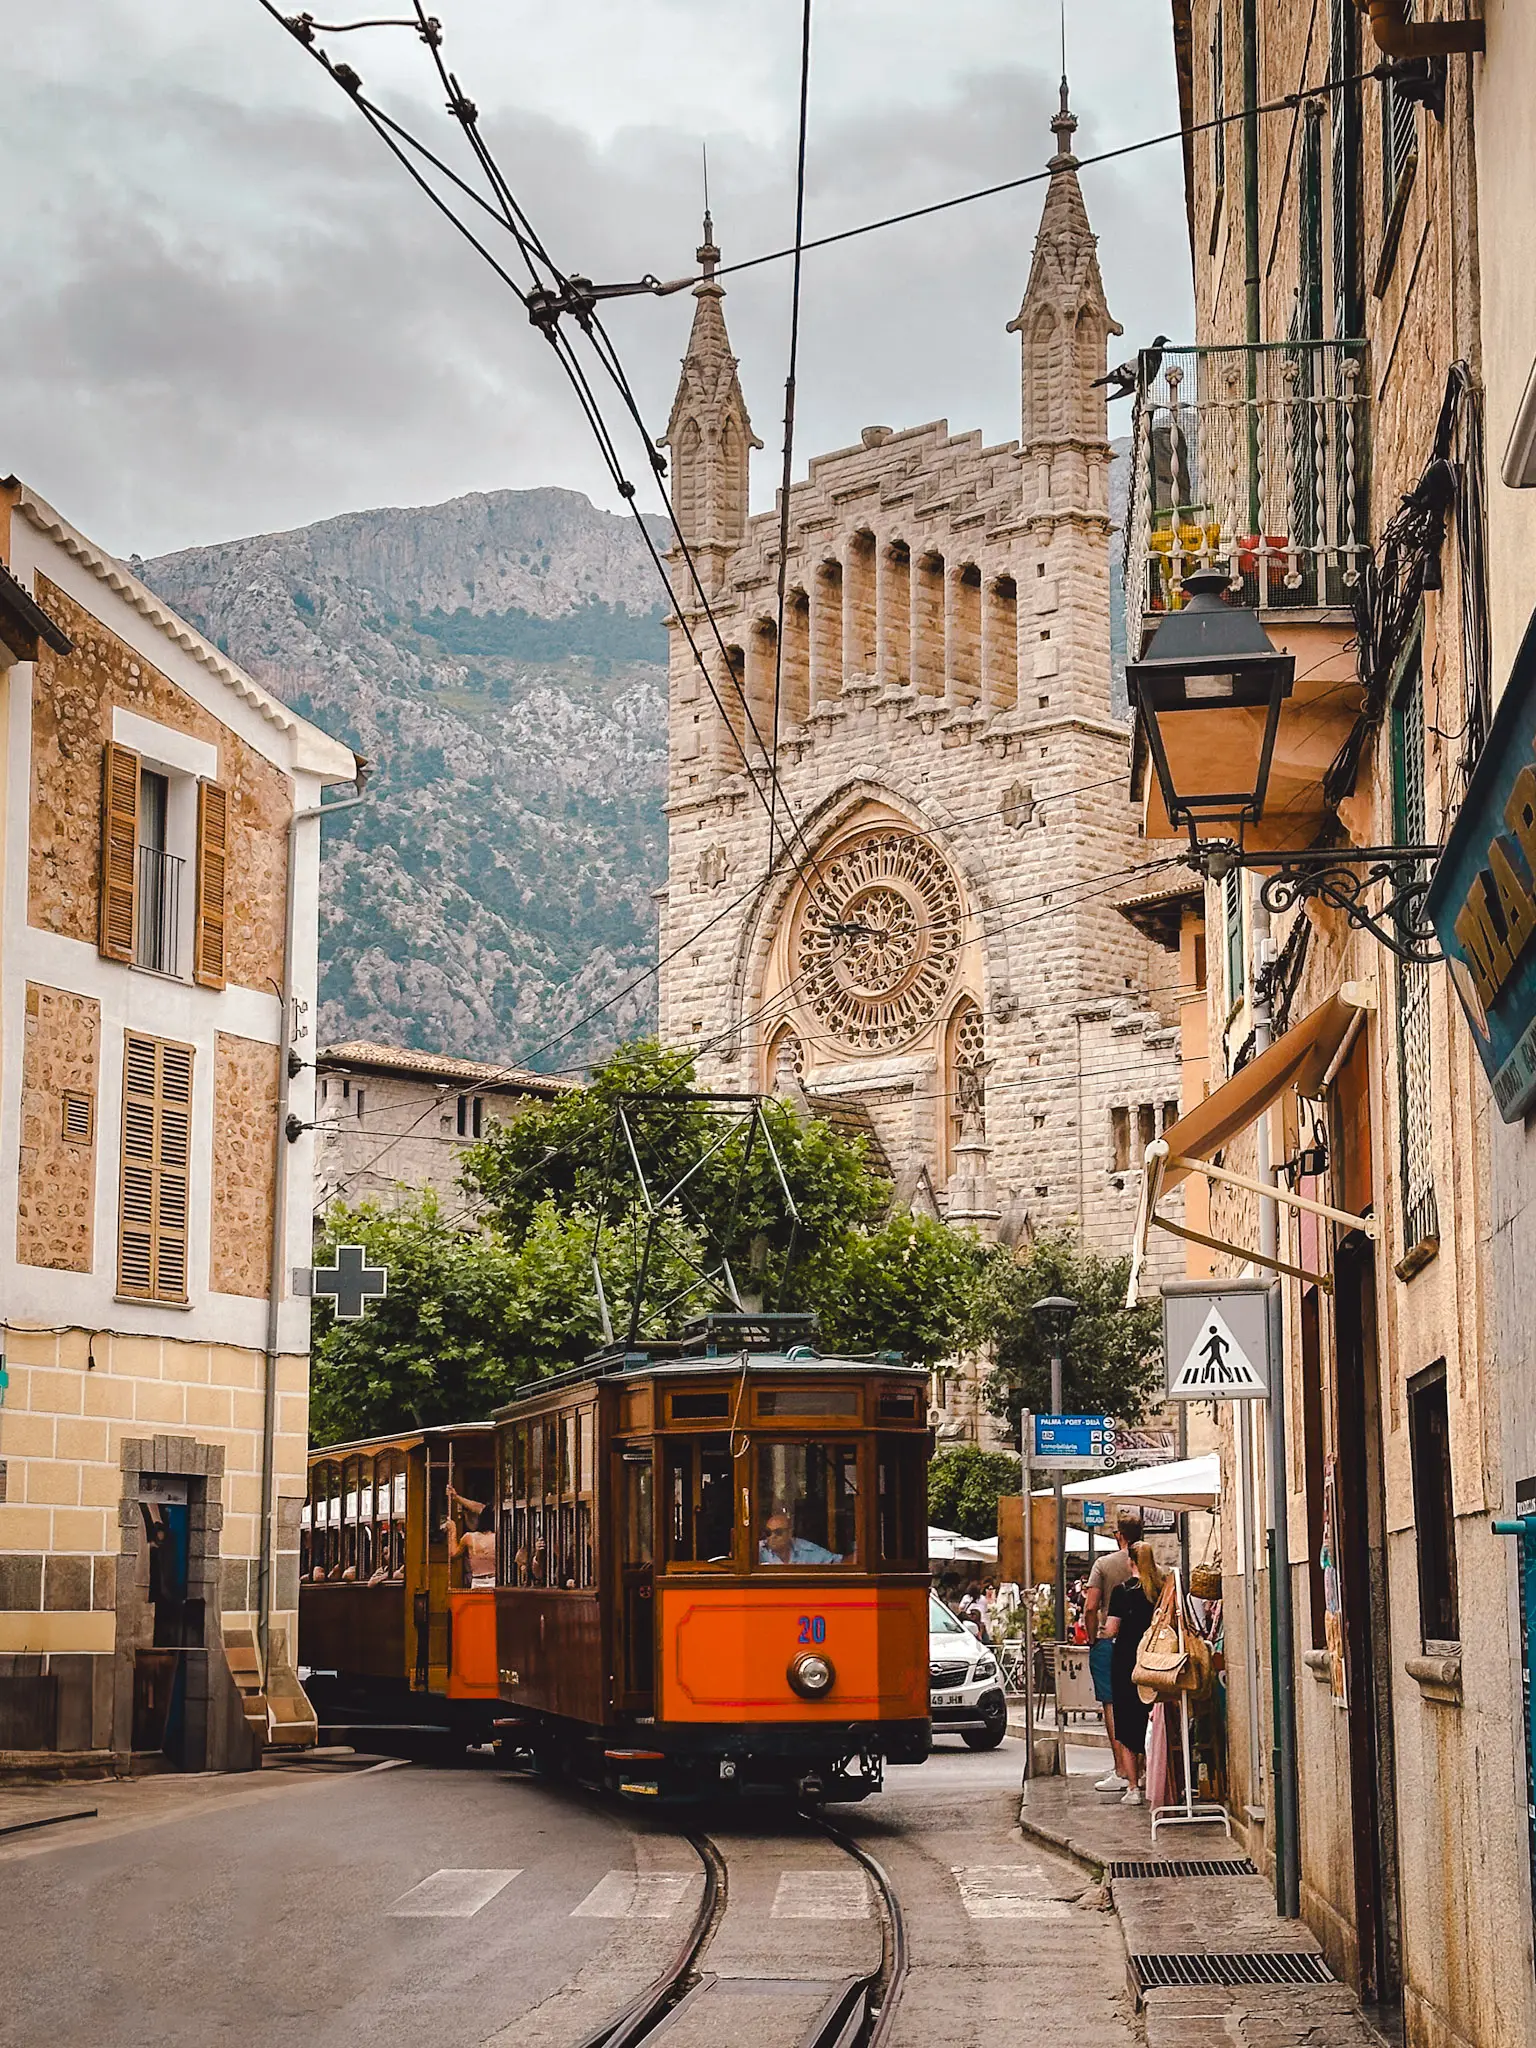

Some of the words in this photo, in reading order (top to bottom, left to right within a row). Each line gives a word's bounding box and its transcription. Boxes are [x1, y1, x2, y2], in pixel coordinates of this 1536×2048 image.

[1040, 1418, 1062, 1426] PALMA
[1065, 1418, 1082, 1426] PORT
[798, 1615, 826, 1644] 20
